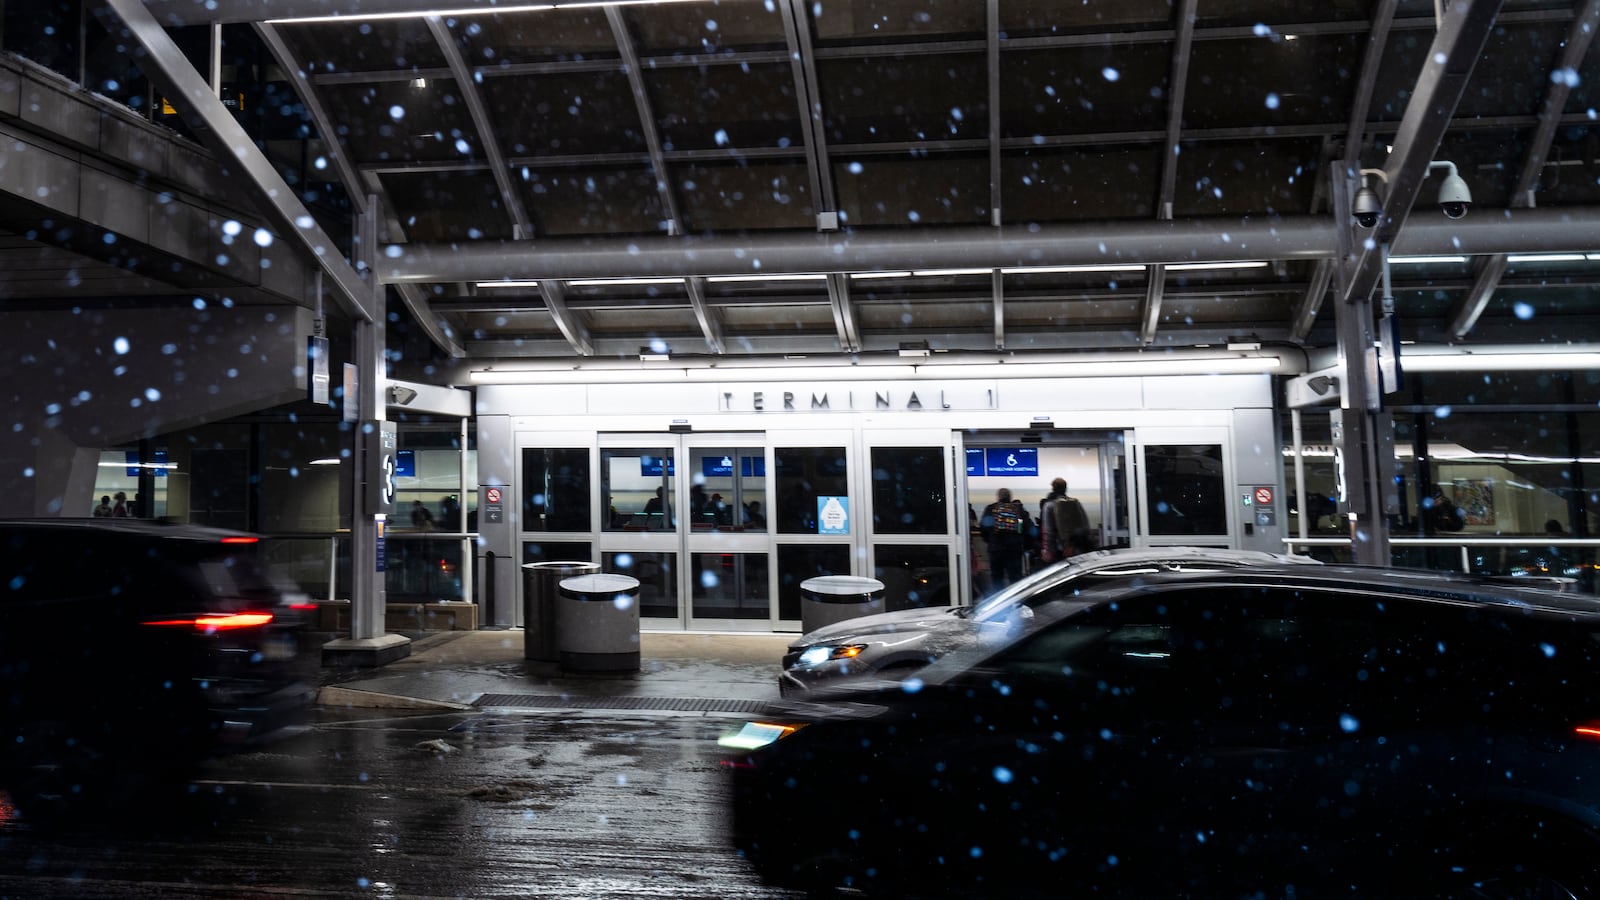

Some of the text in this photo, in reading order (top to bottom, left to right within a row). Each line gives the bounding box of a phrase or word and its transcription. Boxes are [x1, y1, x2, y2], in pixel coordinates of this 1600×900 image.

[723, 389, 993, 410] TERMINAL 1
[382, 454, 394, 505] 3
